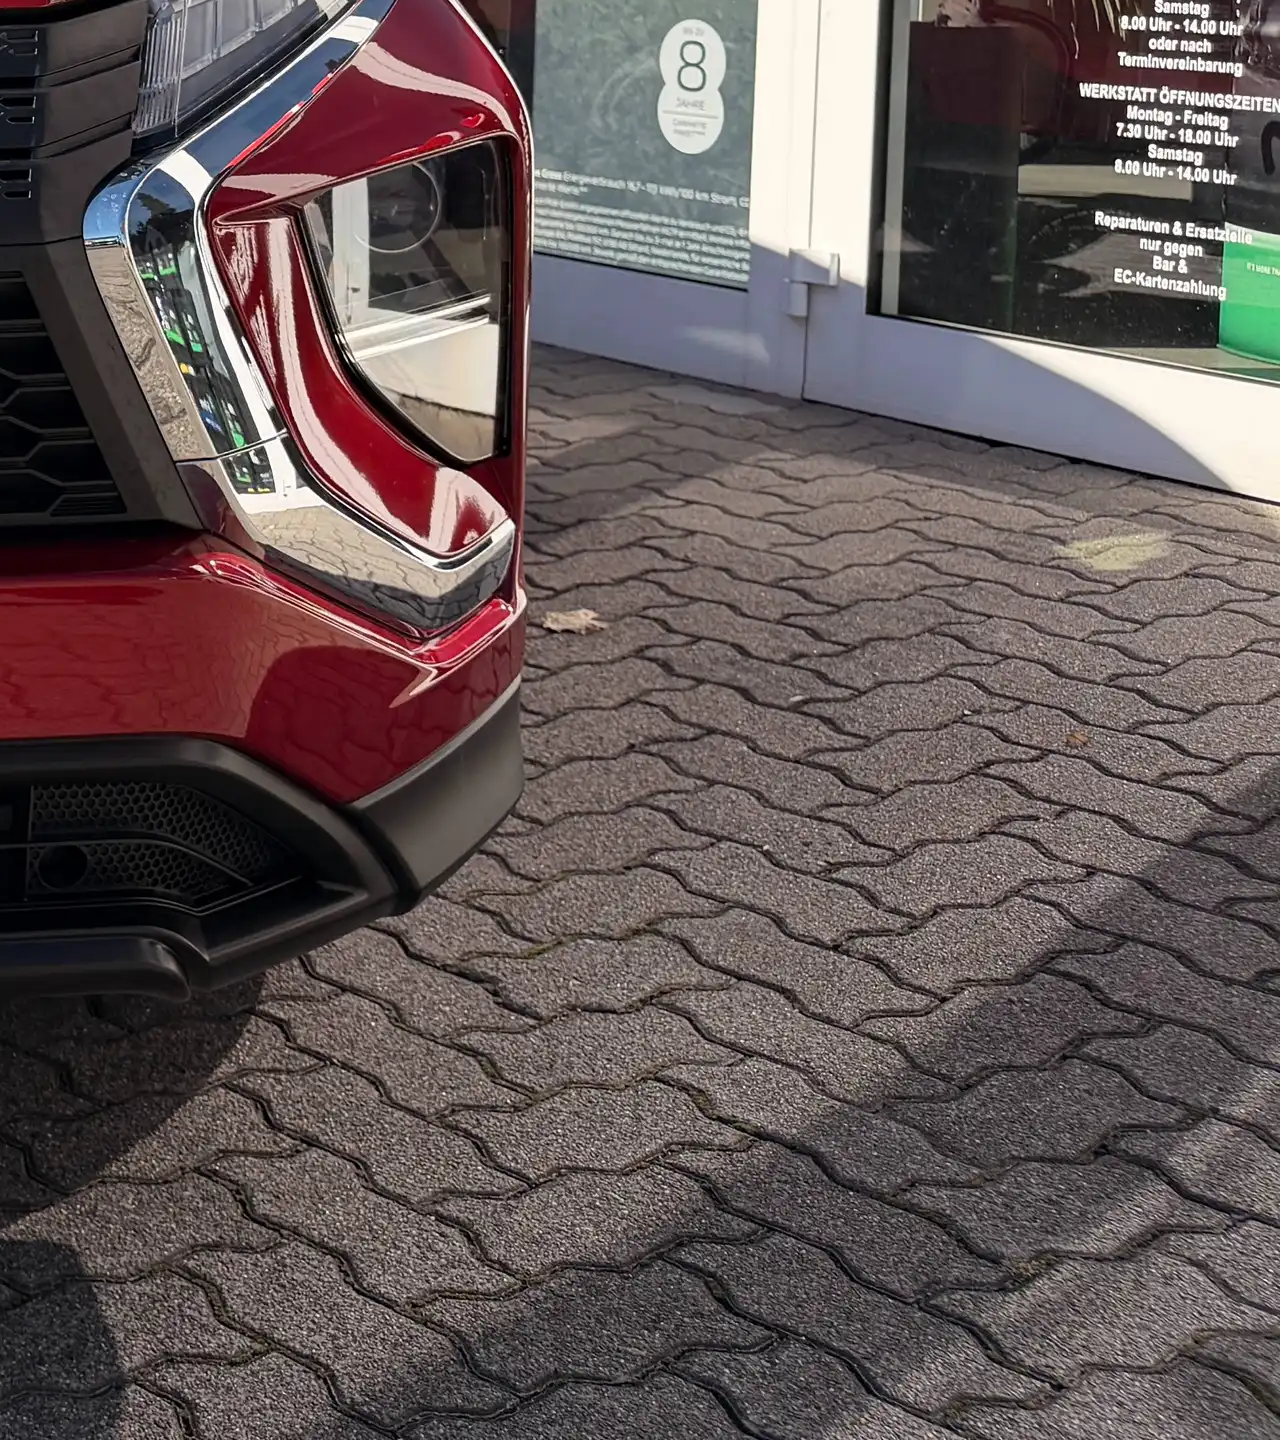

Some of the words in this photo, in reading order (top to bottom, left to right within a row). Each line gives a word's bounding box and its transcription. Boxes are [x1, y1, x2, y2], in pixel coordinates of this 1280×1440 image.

[1154, 0, 1209, 18] Samstag
[1121, 15, 1146, 30] 8.00
[1149, 17, 1172, 32] Uhr
[1183, 19, 1217, 34] 14.00
[1220, 20, 1243, 36] Uhr
[1148, 36, 1178, 52] oder
[1180, 38, 1212, 53] nach
[677, 40, 706, 92] 8
[1117, 52, 1243, 77] Terminvereinbarung
[1079, 82, 1157, 103] WERKSTATT
[1159, 86, 1280, 112] ÖFFNUNGSZEITEN
[1127, 105, 1173, 126] Montag
[1184, 112, 1228, 130] Freitag
[1116, 123, 1141, 138] 7.30
[1144, 125, 1168, 141] Uhr
[1178, 128, 1211, 145] 18.00
[1214, 131, 1239, 148] Uhr
[1148, 144, 1203, 166] Samstag
[1114, 159, 1140, 175] 8.00
[1143, 162, 1166, 178] Uhr
[1176, 165, 1209, 183] 14.00
[1213, 168, 1237, 185] Uhr
[1095, 211, 1169, 234] Reparaturen
[1173, 221, 1182, 235] &
[1185, 222, 1253, 244] Ersatzteile
[1140, 238, 1161, 251] nur
[1164, 241, 1203, 258] gegen
[1153, 256, 1175, 272] Bar
[1178, 259, 1188, 273] &
[1114, 268, 1227, 301] EC-Kartenzahlung
